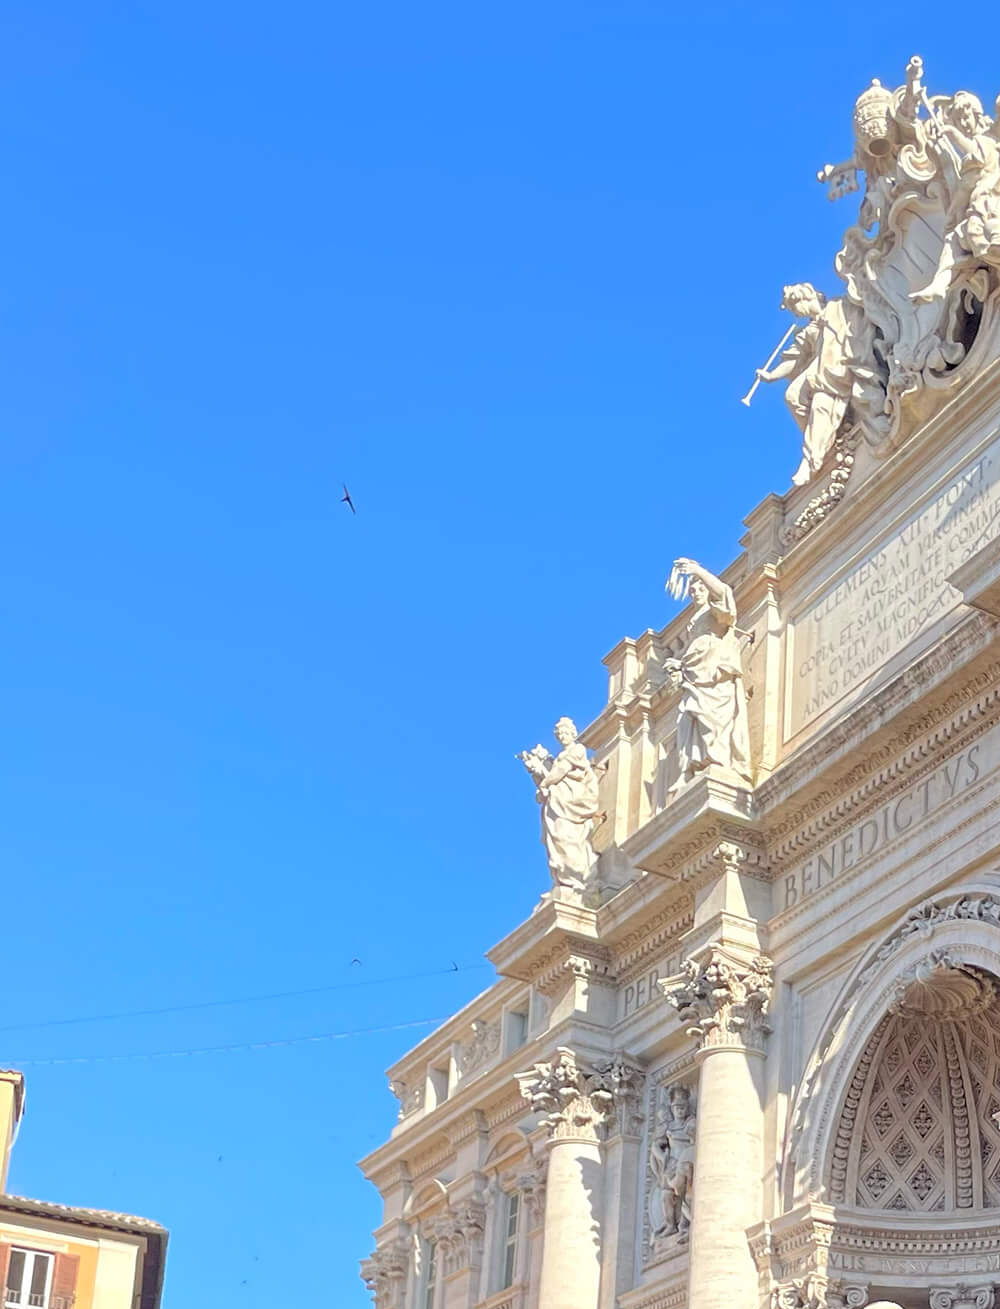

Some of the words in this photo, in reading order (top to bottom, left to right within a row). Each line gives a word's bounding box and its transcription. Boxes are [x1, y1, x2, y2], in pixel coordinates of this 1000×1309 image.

[814, 552, 887, 622] CLEMENS
[862, 552, 909, 608] AQVAM
[839, 623, 853, 645] ET
[843, 637, 889, 687] DOMINI
[783, 745, 980, 909] BENEDICTVS
